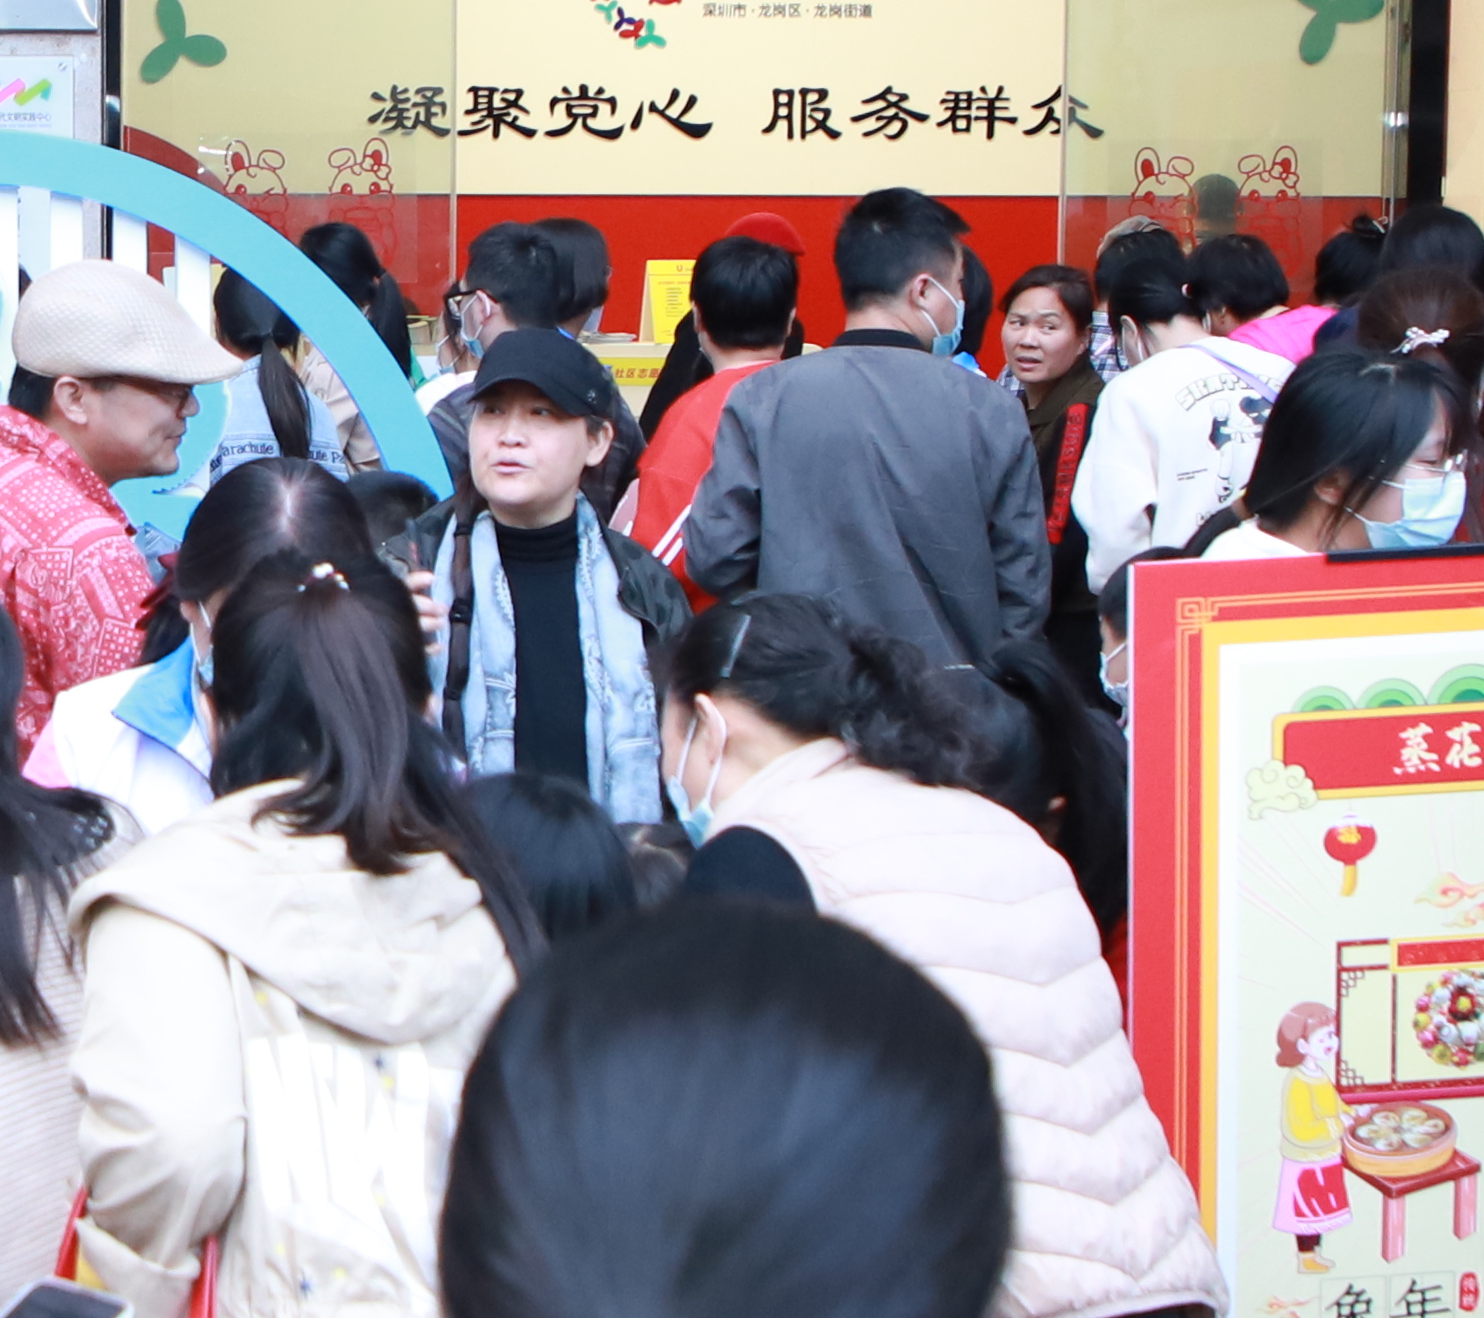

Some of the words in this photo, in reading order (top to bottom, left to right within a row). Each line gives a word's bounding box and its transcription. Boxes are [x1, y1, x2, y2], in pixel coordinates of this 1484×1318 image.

[367, 83, 714, 141] 凝聚党心
[760, 83, 1105, 141] 服务群众
